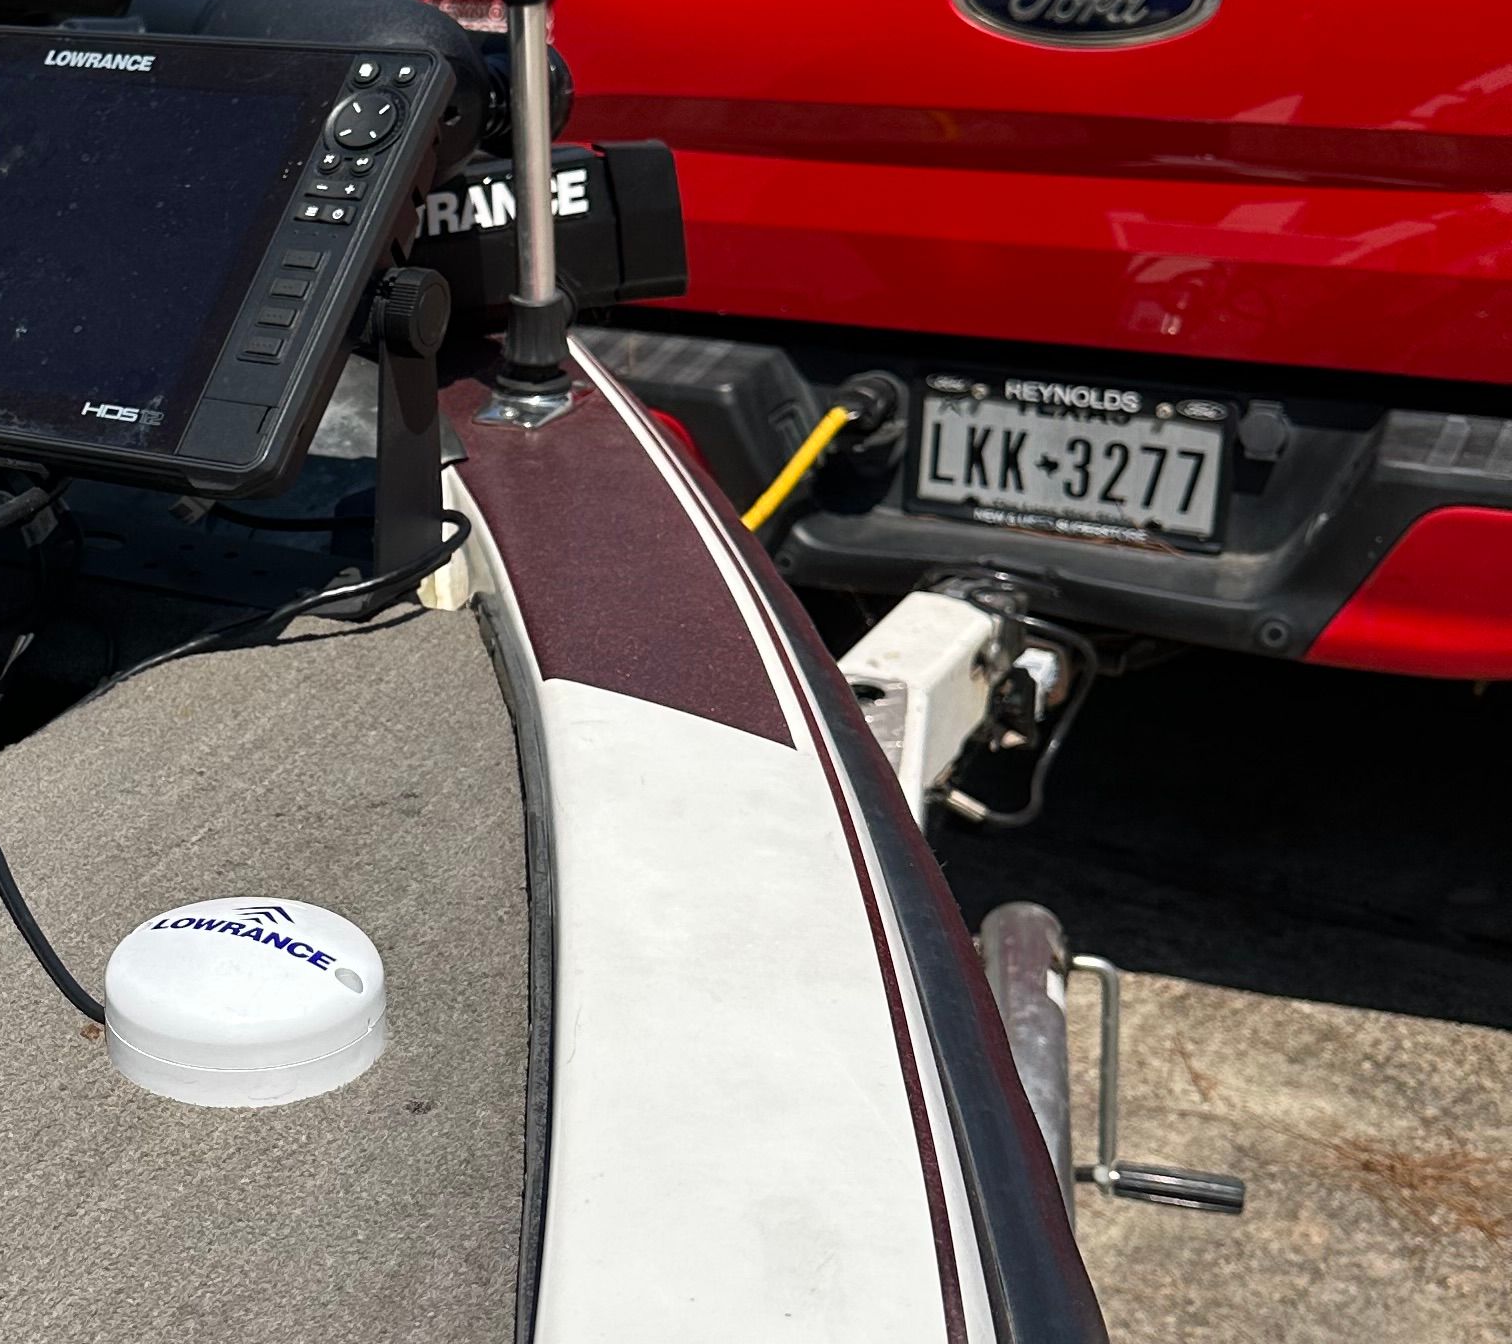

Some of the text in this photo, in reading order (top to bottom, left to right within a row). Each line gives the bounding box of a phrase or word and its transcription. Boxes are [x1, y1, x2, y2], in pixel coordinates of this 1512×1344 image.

[44, 49, 156, 72] LOWRANCE
[1004, 378, 1141, 414] REYNOLDS
[150, 917, 337, 971] LOWRANCE
